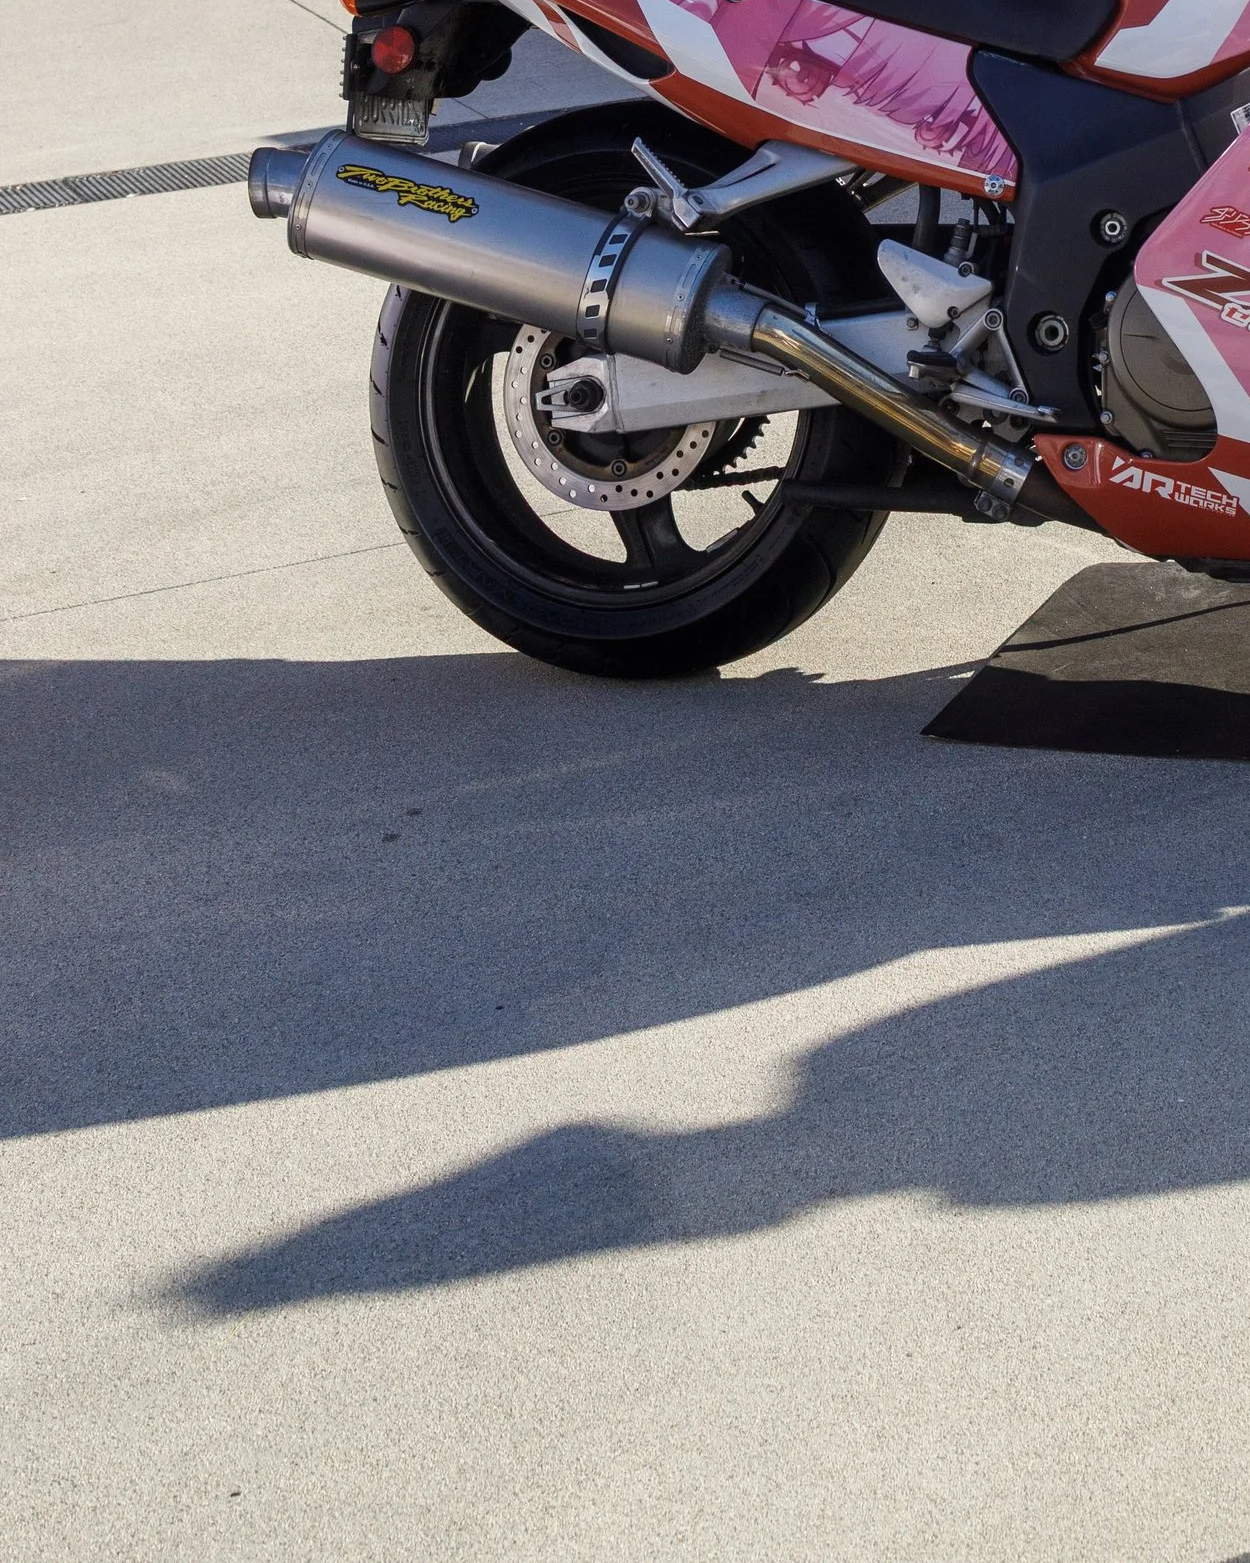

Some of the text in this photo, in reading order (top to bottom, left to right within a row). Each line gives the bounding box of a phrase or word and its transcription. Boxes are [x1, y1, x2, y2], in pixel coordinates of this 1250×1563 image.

[378, 176, 476, 208] Brothers
[398, 192, 471, 221] Racing
[1174, 492, 1238, 516] WORKS
[1176, 480, 1239, 508] TECH
